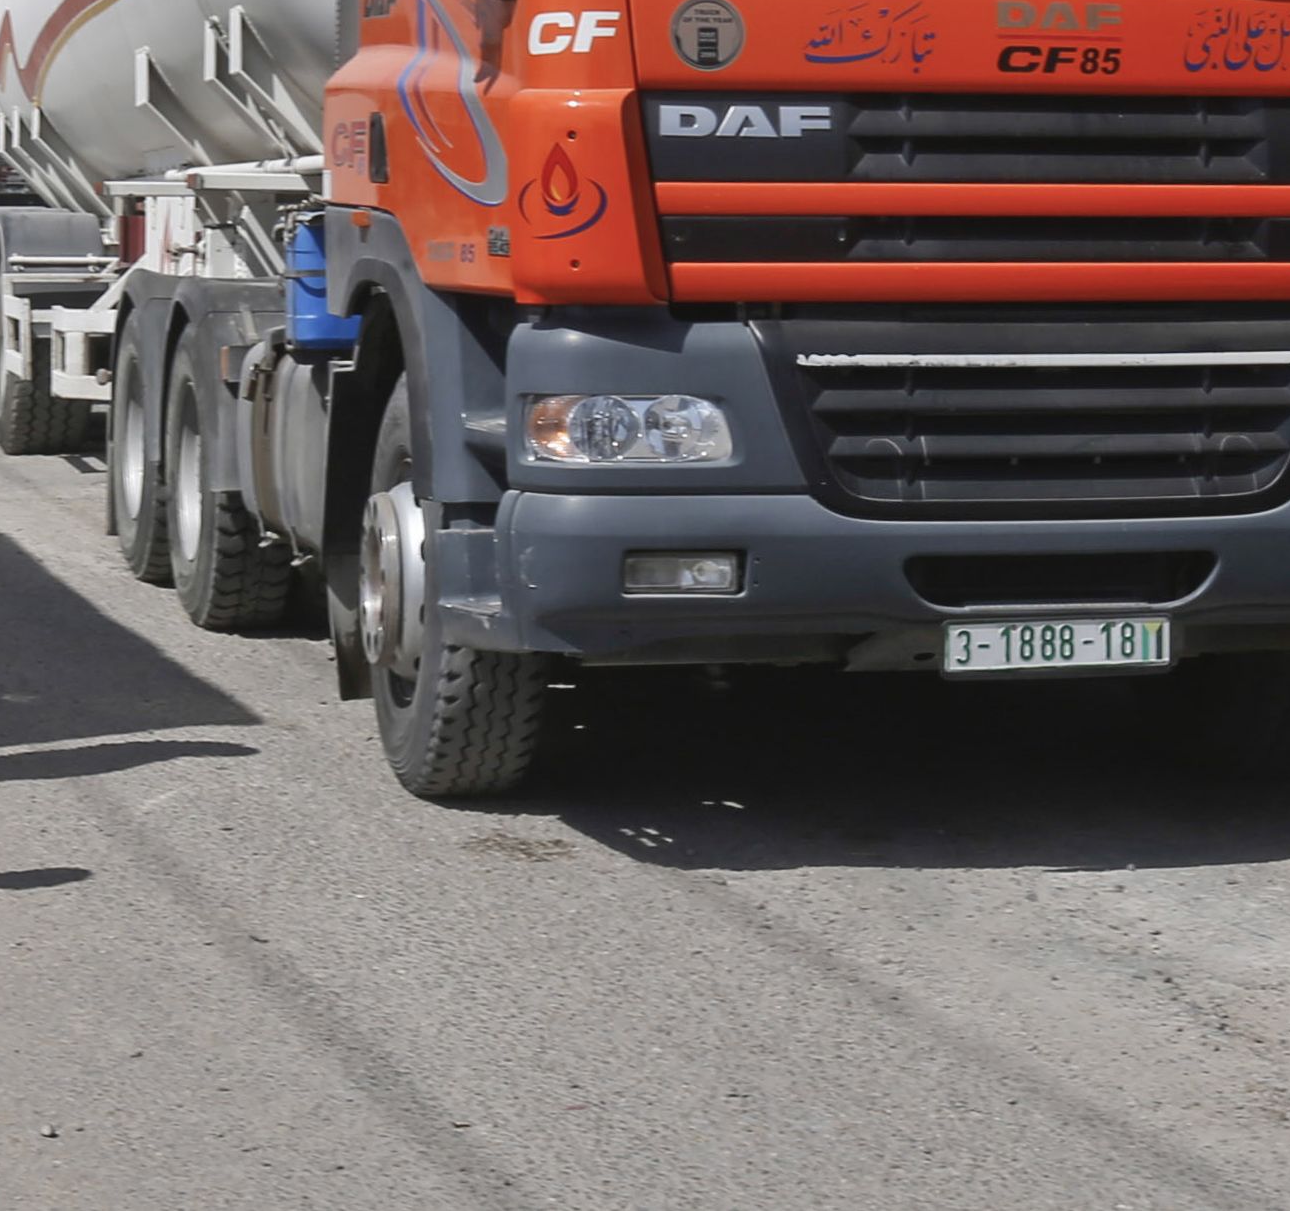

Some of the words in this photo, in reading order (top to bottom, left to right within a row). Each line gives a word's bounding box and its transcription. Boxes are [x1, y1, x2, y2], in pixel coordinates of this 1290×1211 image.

[528, 11, 621, 55] CF
[996, 1, 1122, 32] DAF
[659, 104, 831, 138] DAF
